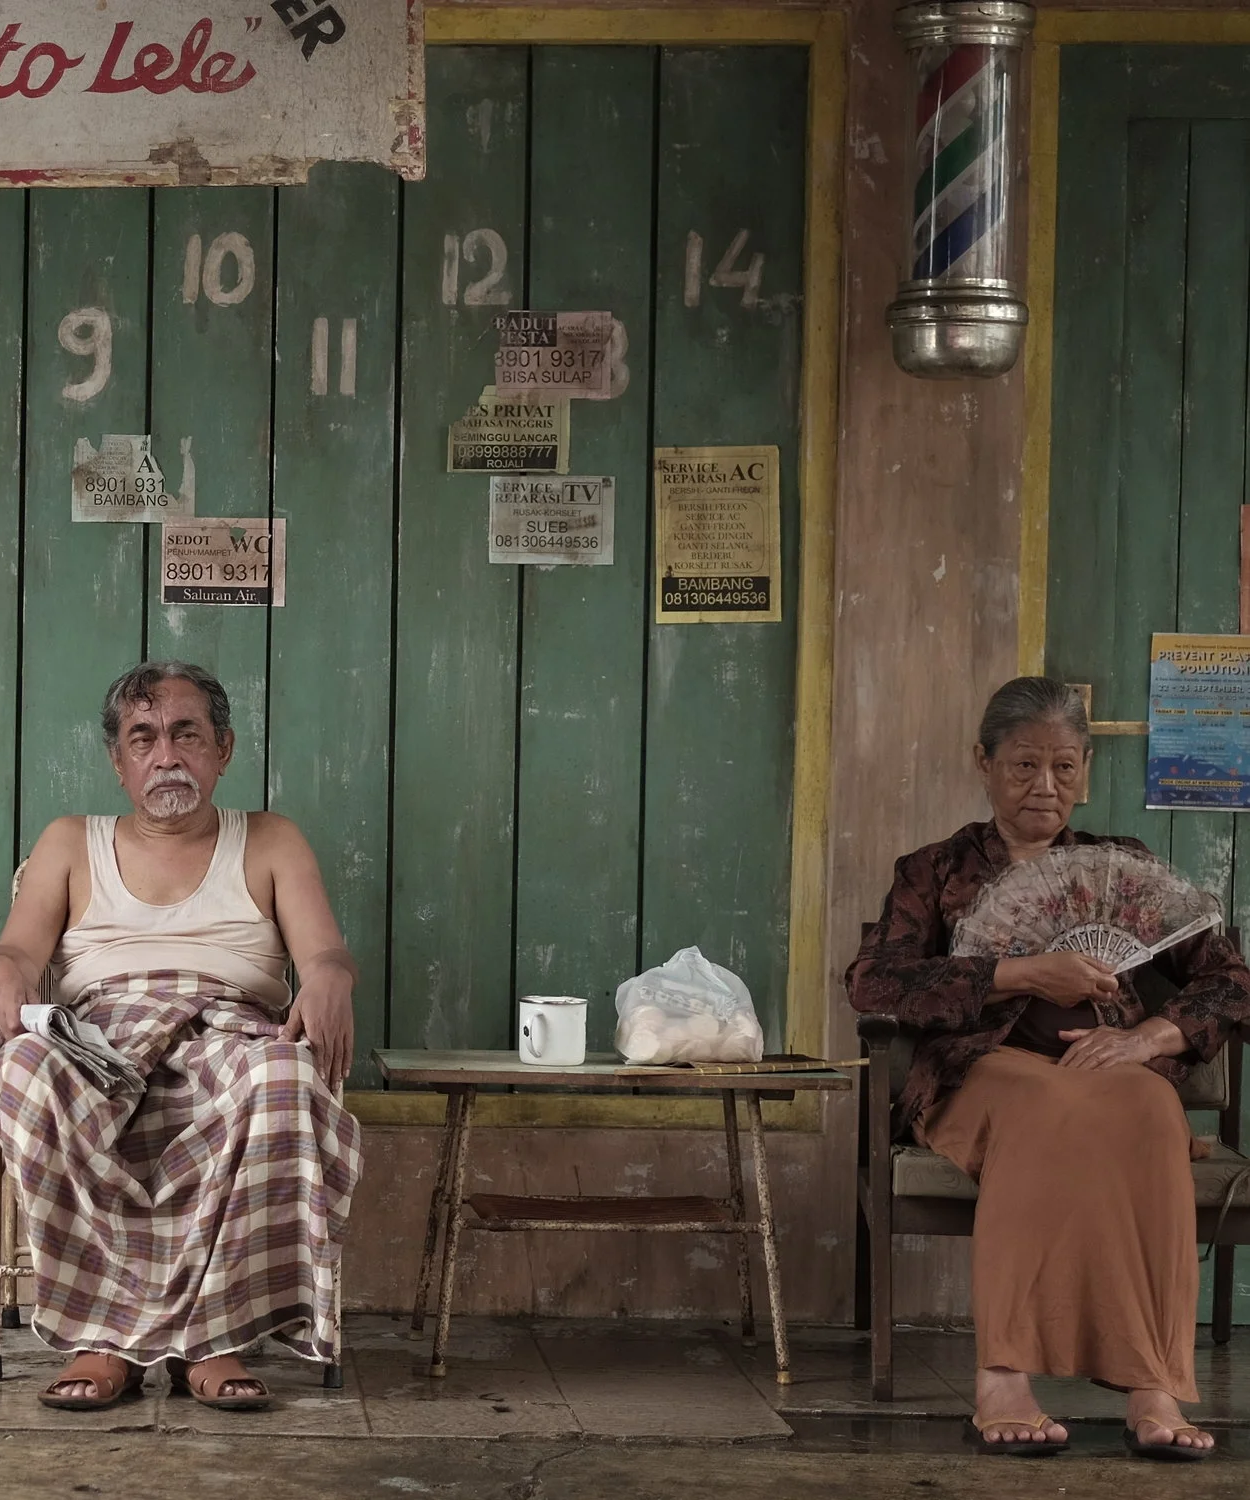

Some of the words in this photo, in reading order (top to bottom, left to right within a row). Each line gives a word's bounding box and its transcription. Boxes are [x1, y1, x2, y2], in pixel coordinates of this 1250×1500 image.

[182, 231, 255, 307] 10
[442, 228, 513, 306] 12
[683, 228, 765, 308] 14
[495, 317, 556, 331] BADUT
[501, 331, 549, 345] ESTA
[57, 306, 113, 401] 9
[311, 317, 357, 396] 11
[550, 349, 602, 368] 9317
[502, 370, 537, 384] BISA
[541, 370, 592, 384] SULAP
[468, 404, 489, 418] ES
[494, 404, 555, 418] PRIVAT
[462, 419, 503, 429] AHASA
[506, 419, 554, 429] INGGRIS
[453, 432, 510, 443] SEMINGGU
[513, 433, 558, 443] LANCAR
[457, 445, 553, 459] 08999888777
[136, 454, 155, 473] A
[486, 459, 524, 469] ROJALI
[662, 462, 719, 473] SERVICE
[663, 473, 727, 484] REPARASI
[730, 462, 765, 481] AC
[85, 477, 127, 492] 8901
[494, 482, 552, 494] SERVICE
[93, 493, 169, 507] BAMBANG
[494, 493, 561, 504] REPARASI
[564, 484, 598, 502] TV
[685, 513, 725, 521] SERVICE
[526, 520, 569, 533] SUEB
[167, 535, 212, 545] SEDOT
[230, 535, 270, 554] WC
[495, 534, 599, 549] 081306449536
[166, 562, 213, 581] 8901
[223, 563, 270, 581] 9317
[678, 577, 754, 591] BAMBANG
[183, 588, 232, 601] Saluran
[665, 591, 767, 605] 081306449536
[1158, 651, 1215, 662] PREVENT
